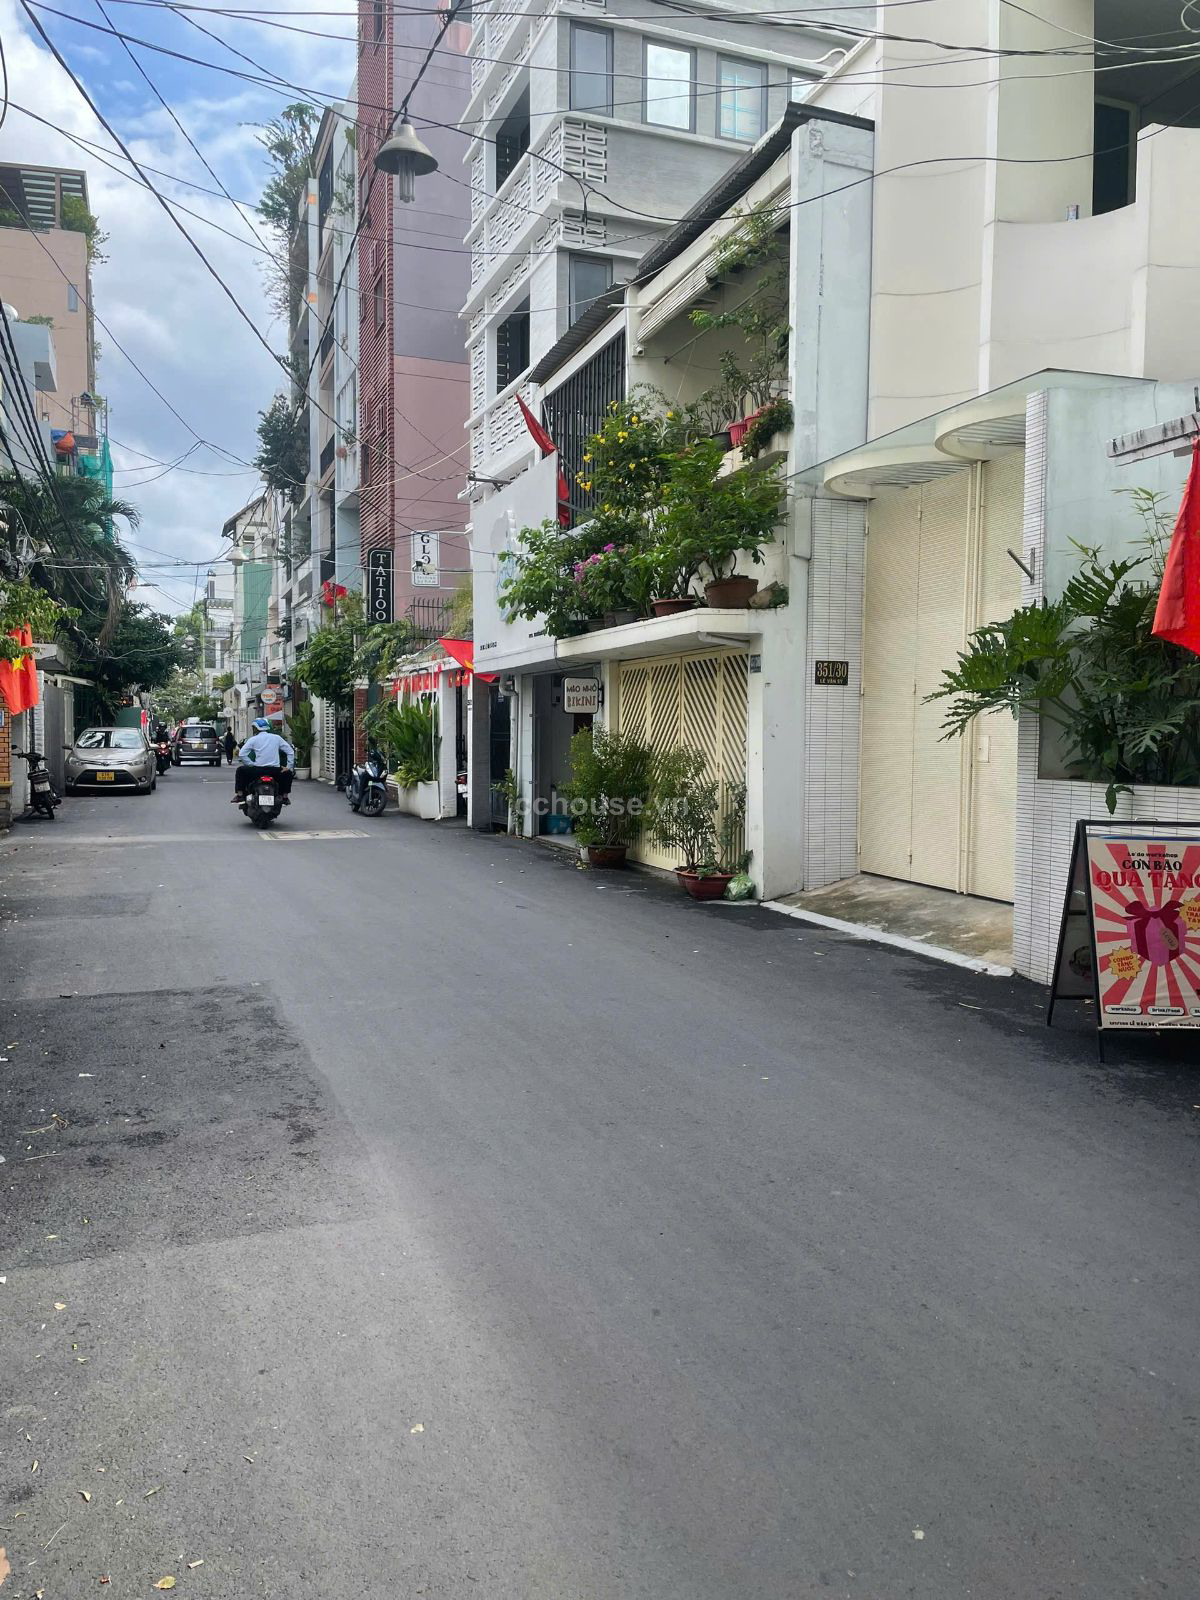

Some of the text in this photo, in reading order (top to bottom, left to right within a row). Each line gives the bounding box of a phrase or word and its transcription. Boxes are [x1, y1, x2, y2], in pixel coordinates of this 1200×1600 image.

[375, 553, 387, 621] TATTOO
[817, 662, 848, 678] 351/30
[567, 694, 596, 708] BIKINI
